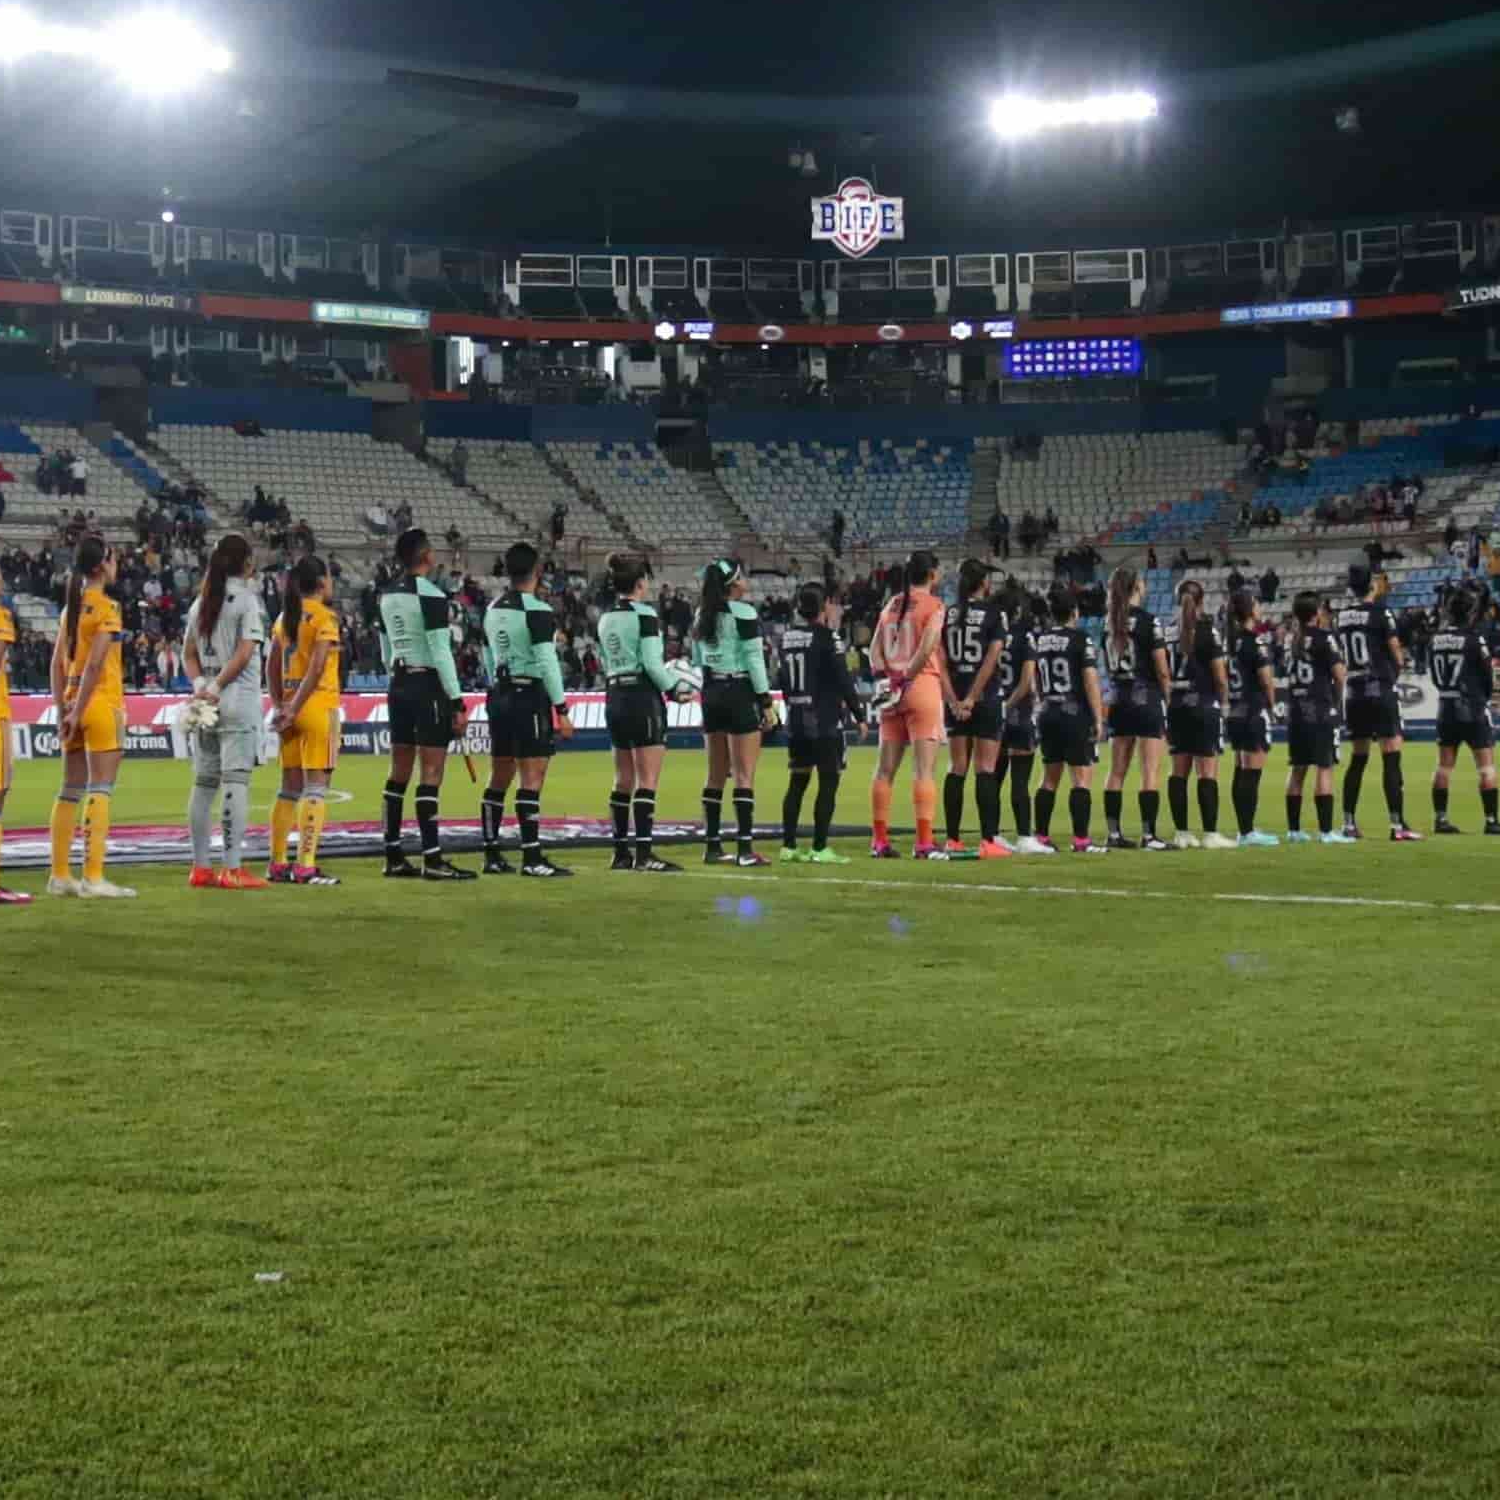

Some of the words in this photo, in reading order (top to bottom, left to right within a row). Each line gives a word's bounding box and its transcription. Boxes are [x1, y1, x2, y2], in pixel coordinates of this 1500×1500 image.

[820, 203, 895, 232] BIFE
[1460, 285, 1500, 303] TUDN
[947, 625, 983, 663] 05
[1338, 630, 1369, 666] 10
[785, 652, 805, 692] 11
[1037, 656, 1072, 693] 09
[1433, 653, 1464, 687] 07
[124, 734, 168, 750] orona
[340, 732, 369, 747] rona
